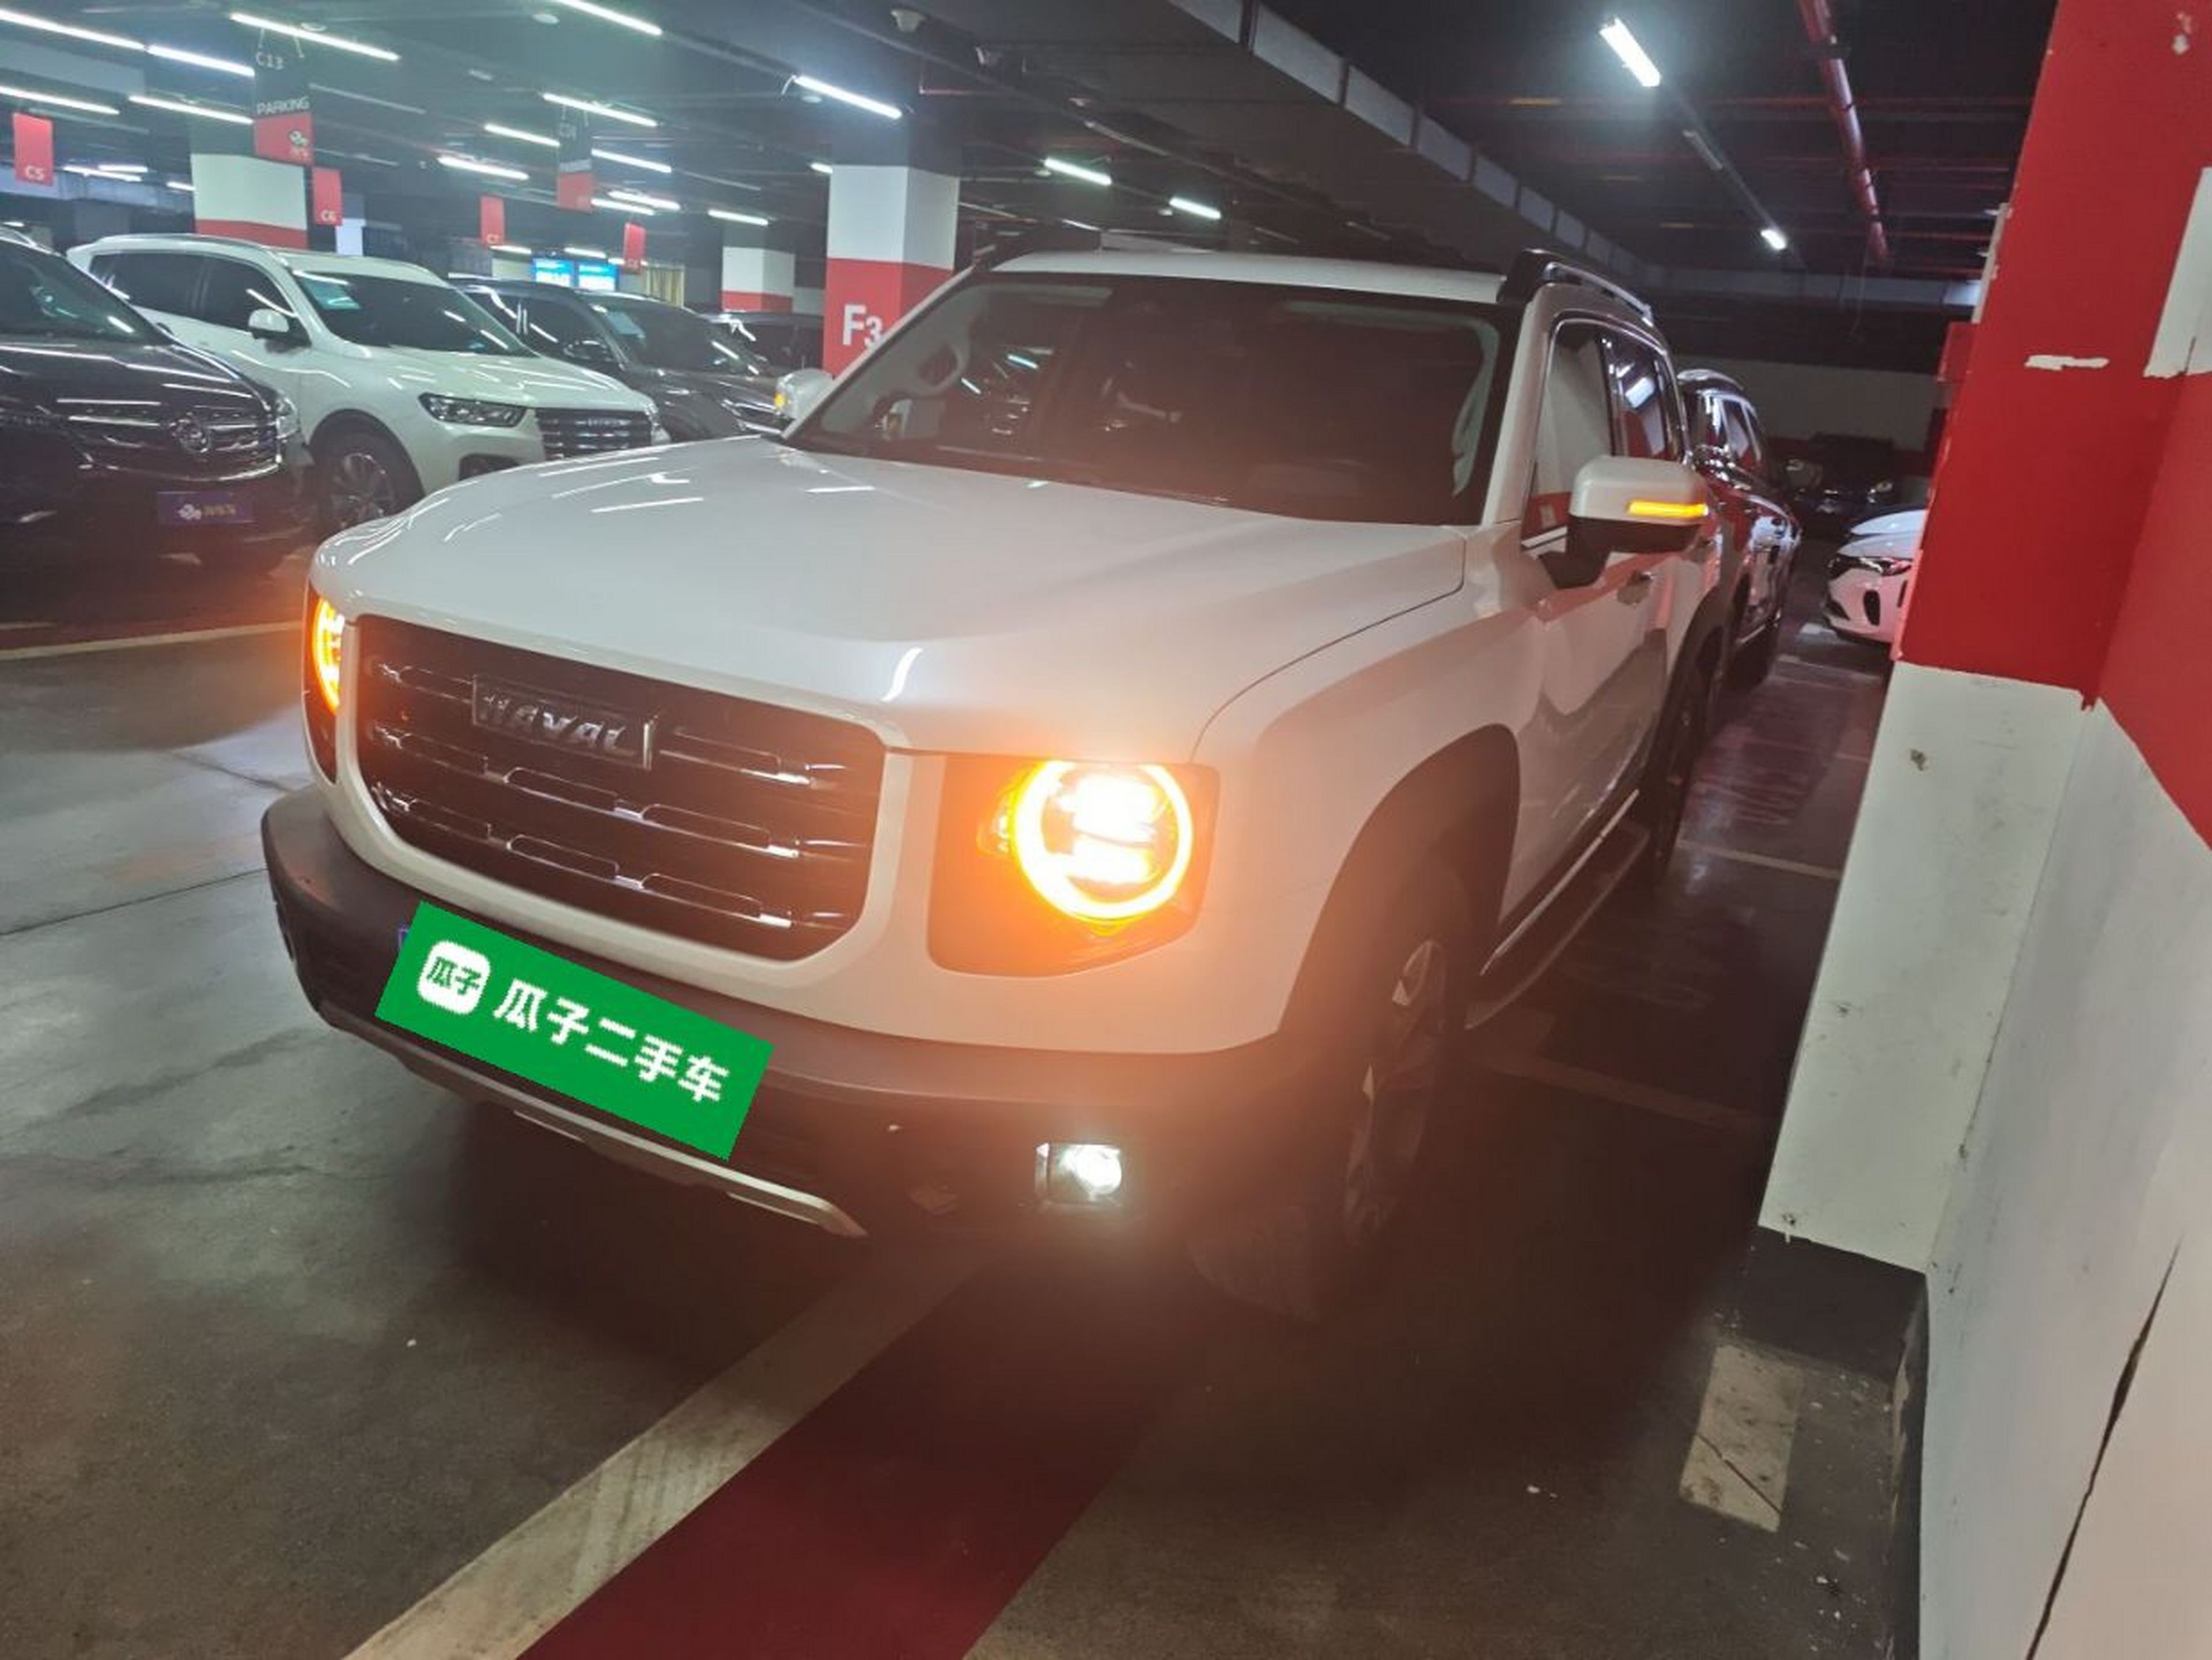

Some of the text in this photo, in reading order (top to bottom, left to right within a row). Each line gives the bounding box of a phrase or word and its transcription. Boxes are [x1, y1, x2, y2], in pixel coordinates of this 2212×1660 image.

[256, 51, 284, 70] C13
[257, 96, 309, 115] PARKING
[842, 304, 883, 349] F3
